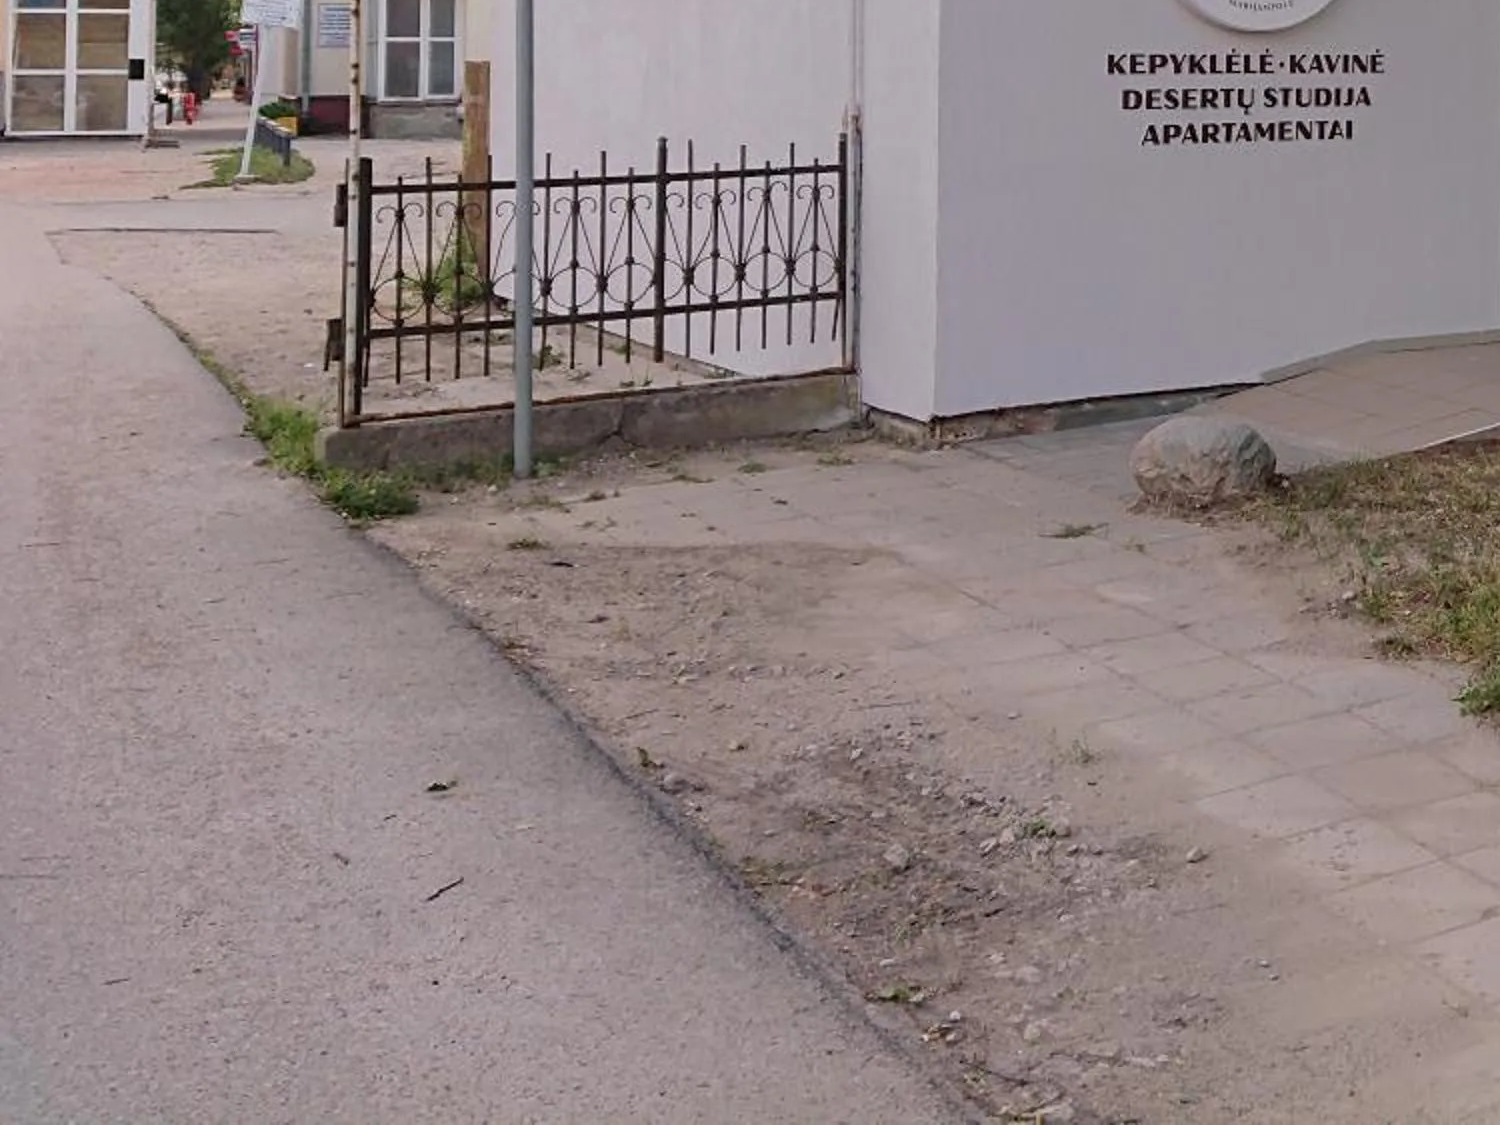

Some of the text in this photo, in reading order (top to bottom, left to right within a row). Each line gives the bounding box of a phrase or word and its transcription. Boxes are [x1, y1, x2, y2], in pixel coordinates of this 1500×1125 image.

[1106, 48, 1385, 75] KEPYKLĖLĖ KAVINĖ
[1121, 86, 1372, 115] DESERTŲ STUDIJA
[1141, 119, 1354, 146] APARTAMENTAI
